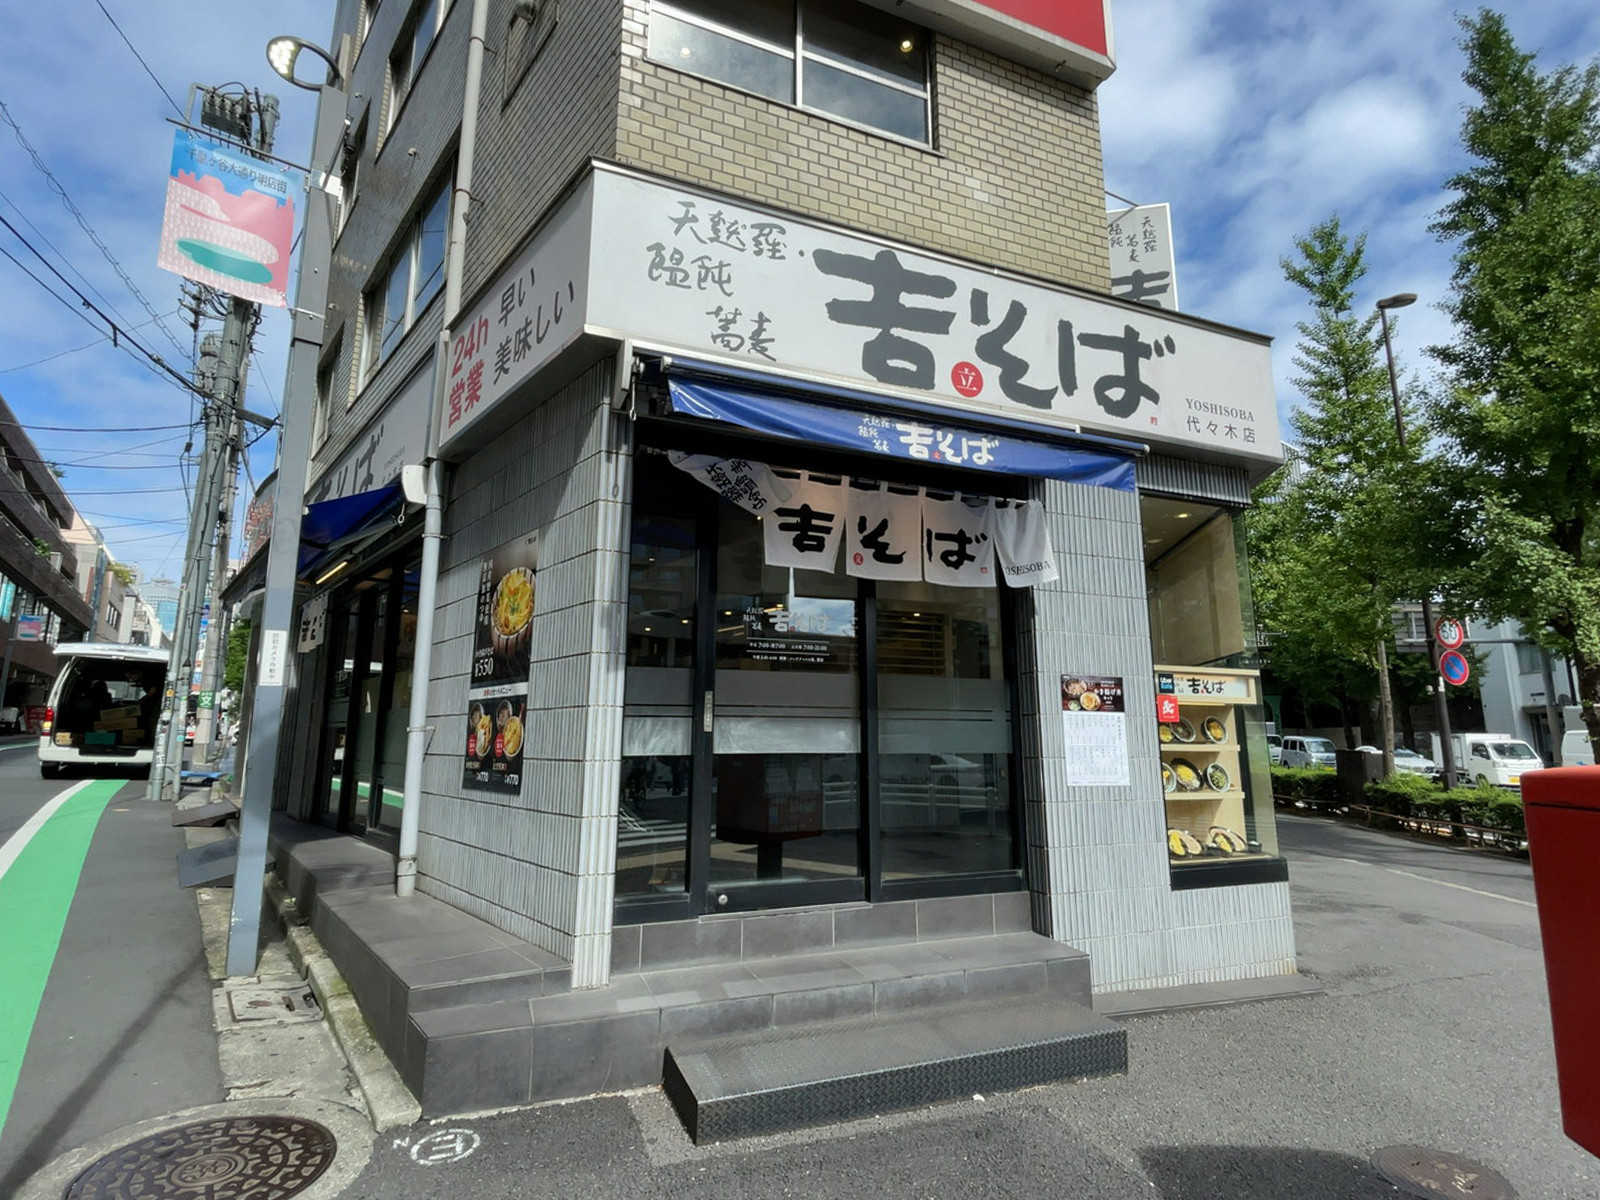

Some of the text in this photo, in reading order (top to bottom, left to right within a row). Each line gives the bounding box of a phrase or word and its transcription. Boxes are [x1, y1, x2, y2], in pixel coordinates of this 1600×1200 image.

[498, 267, 535, 327] 早い
[452, 315, 489, 378] 24h
[493, 280, 574, 385] 美味しい
[812, 249, 1175, 418] 吉そば
[448, 359, 485, 428] 営業
[1186, 398, 1255, 422] YOSHISOBA
[896, 422, 1000, 465] 吉そば
[1186, 415, 1256, 444] 代々木店
[774, 503, 988, 571] 吉そば
[1186, 677, 1226, 695] 吉そば
